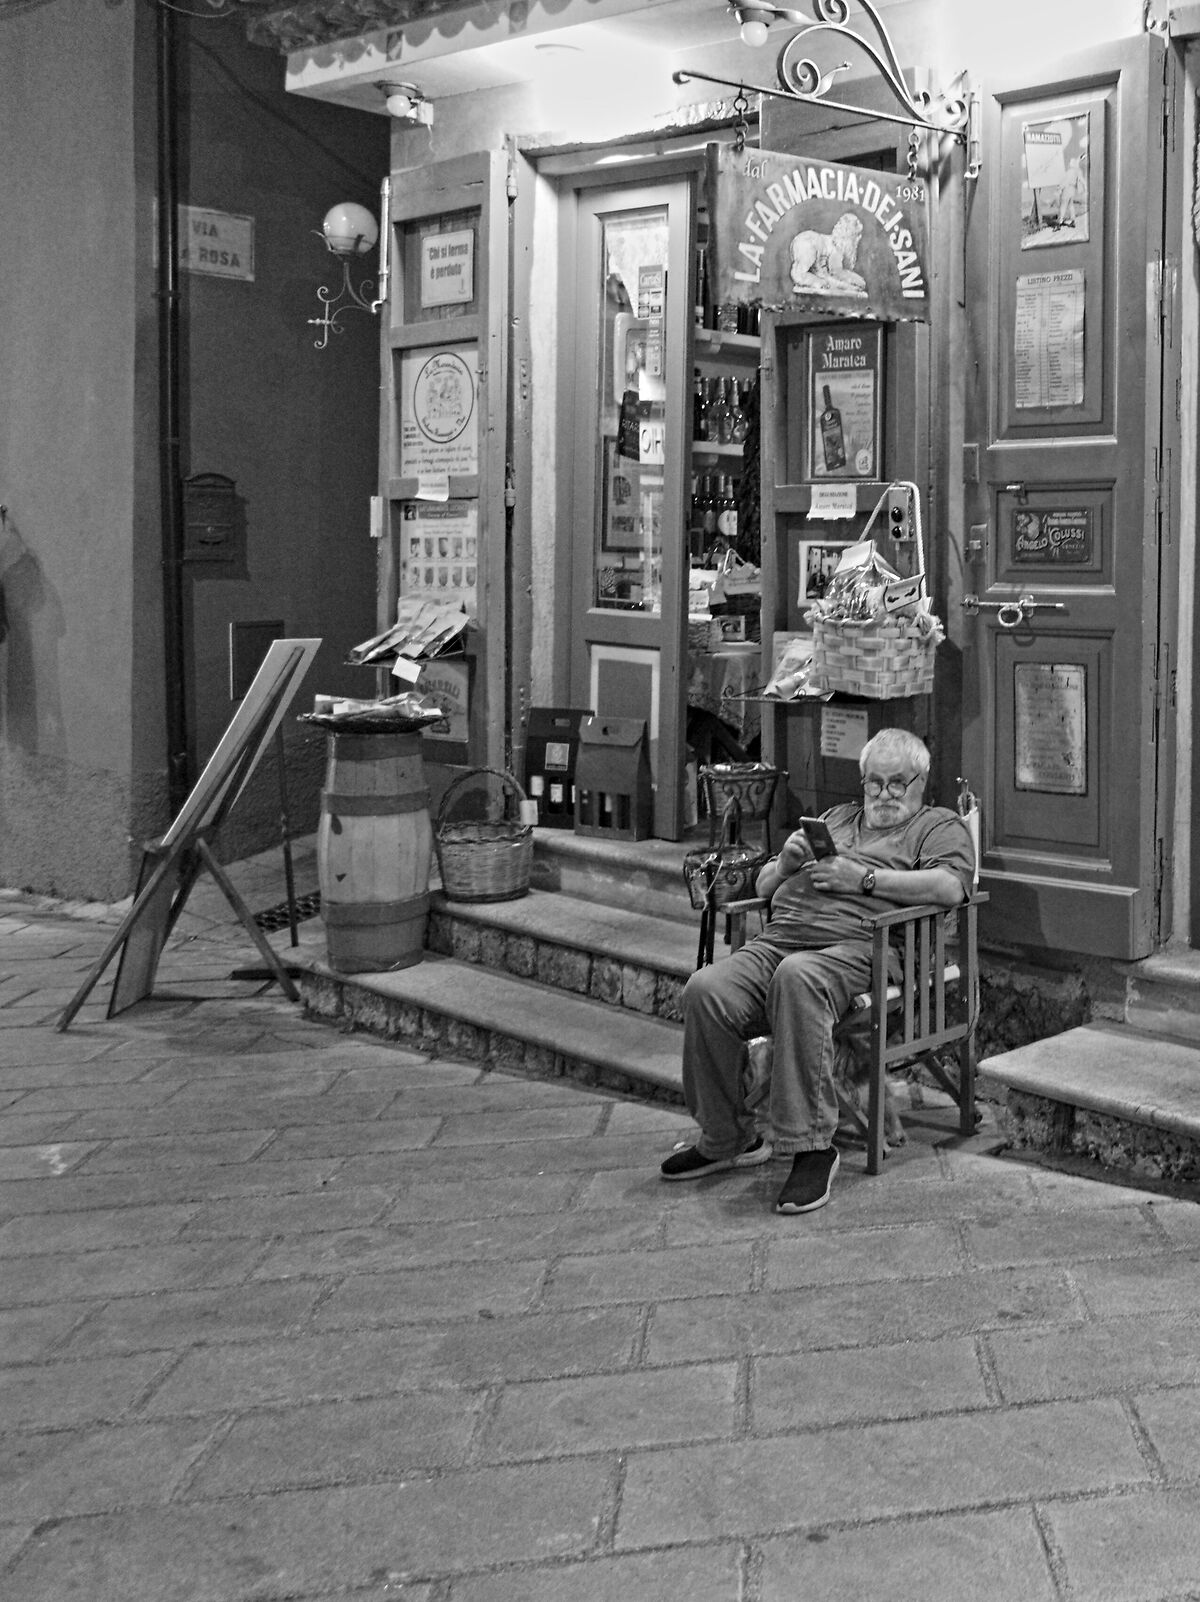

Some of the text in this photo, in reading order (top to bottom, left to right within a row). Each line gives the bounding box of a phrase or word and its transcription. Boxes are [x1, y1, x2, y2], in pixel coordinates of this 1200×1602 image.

[742, 155, 926, 203] dal 1981
[192, 219, 219, 238] VIA
[199, 246, 241, 268] ROSA
[826, 335, 862, 353] Amaro
[822, 352, 867, 369] Maratea
[1049, 527, 1085, 546] COLUSSI
